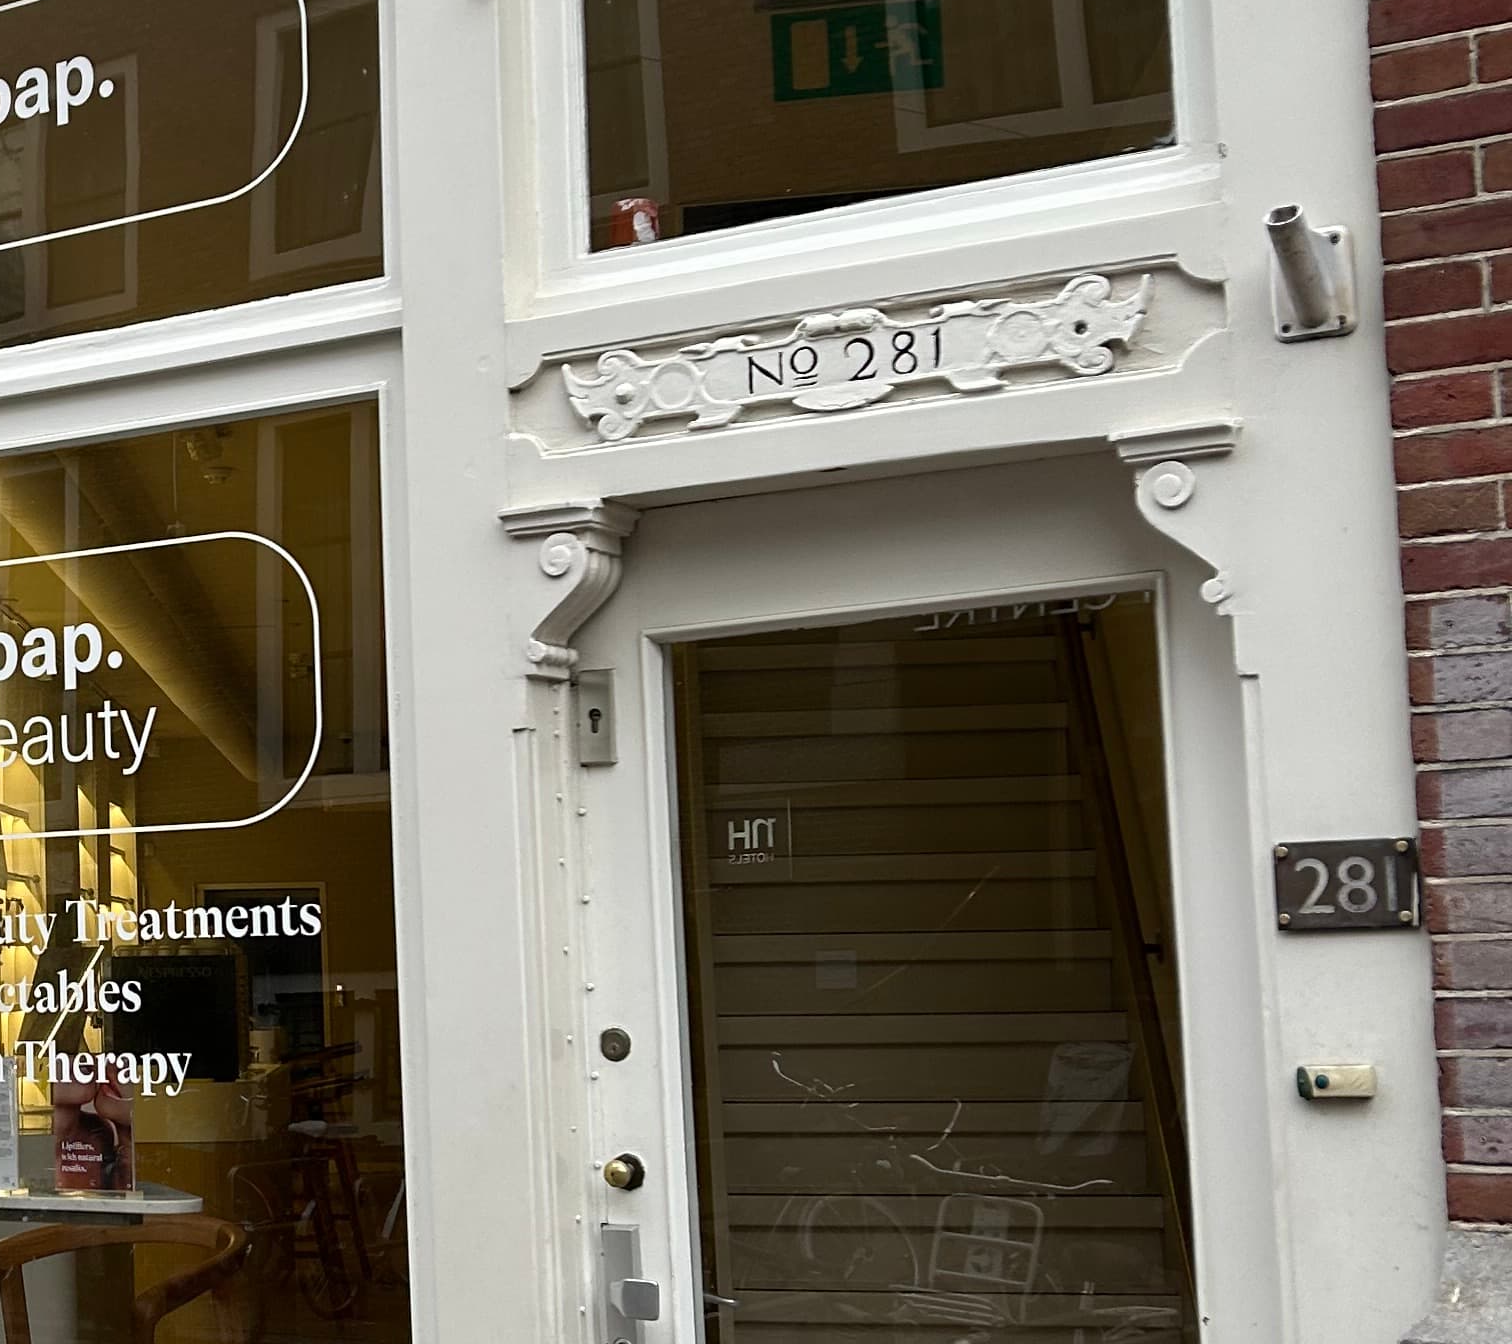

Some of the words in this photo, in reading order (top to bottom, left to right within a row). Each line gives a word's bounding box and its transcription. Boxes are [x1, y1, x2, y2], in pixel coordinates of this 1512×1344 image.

[843, 326, 942, 382] 281
[1294, 855, 1399, 913] 281
[65, 895, 322, 943] Treatments
[12, 1039, 193, 1097] Therapy
